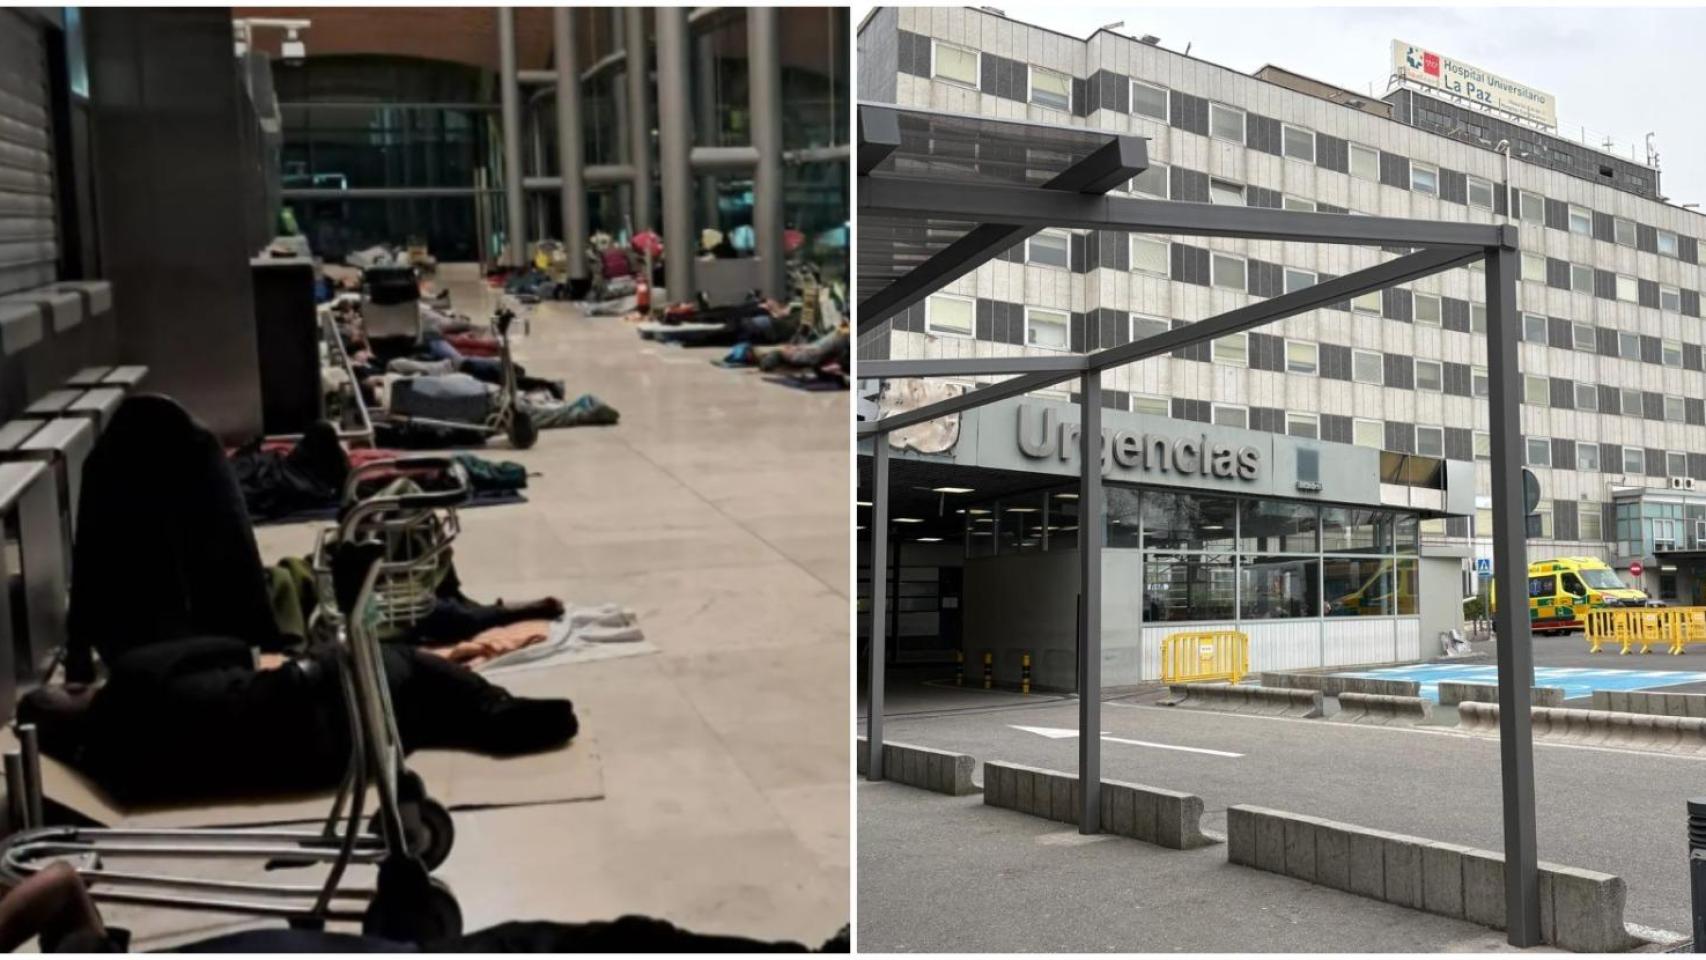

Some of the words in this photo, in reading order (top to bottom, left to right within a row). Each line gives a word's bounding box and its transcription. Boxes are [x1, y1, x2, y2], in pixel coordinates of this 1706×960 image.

[1444, 58, 1485, 82] Hospital
[1487, 75, 1546, 104] Universitario
[1445, 75, 1461, 93] La
[1466, 82, 1492, 104] Paz
